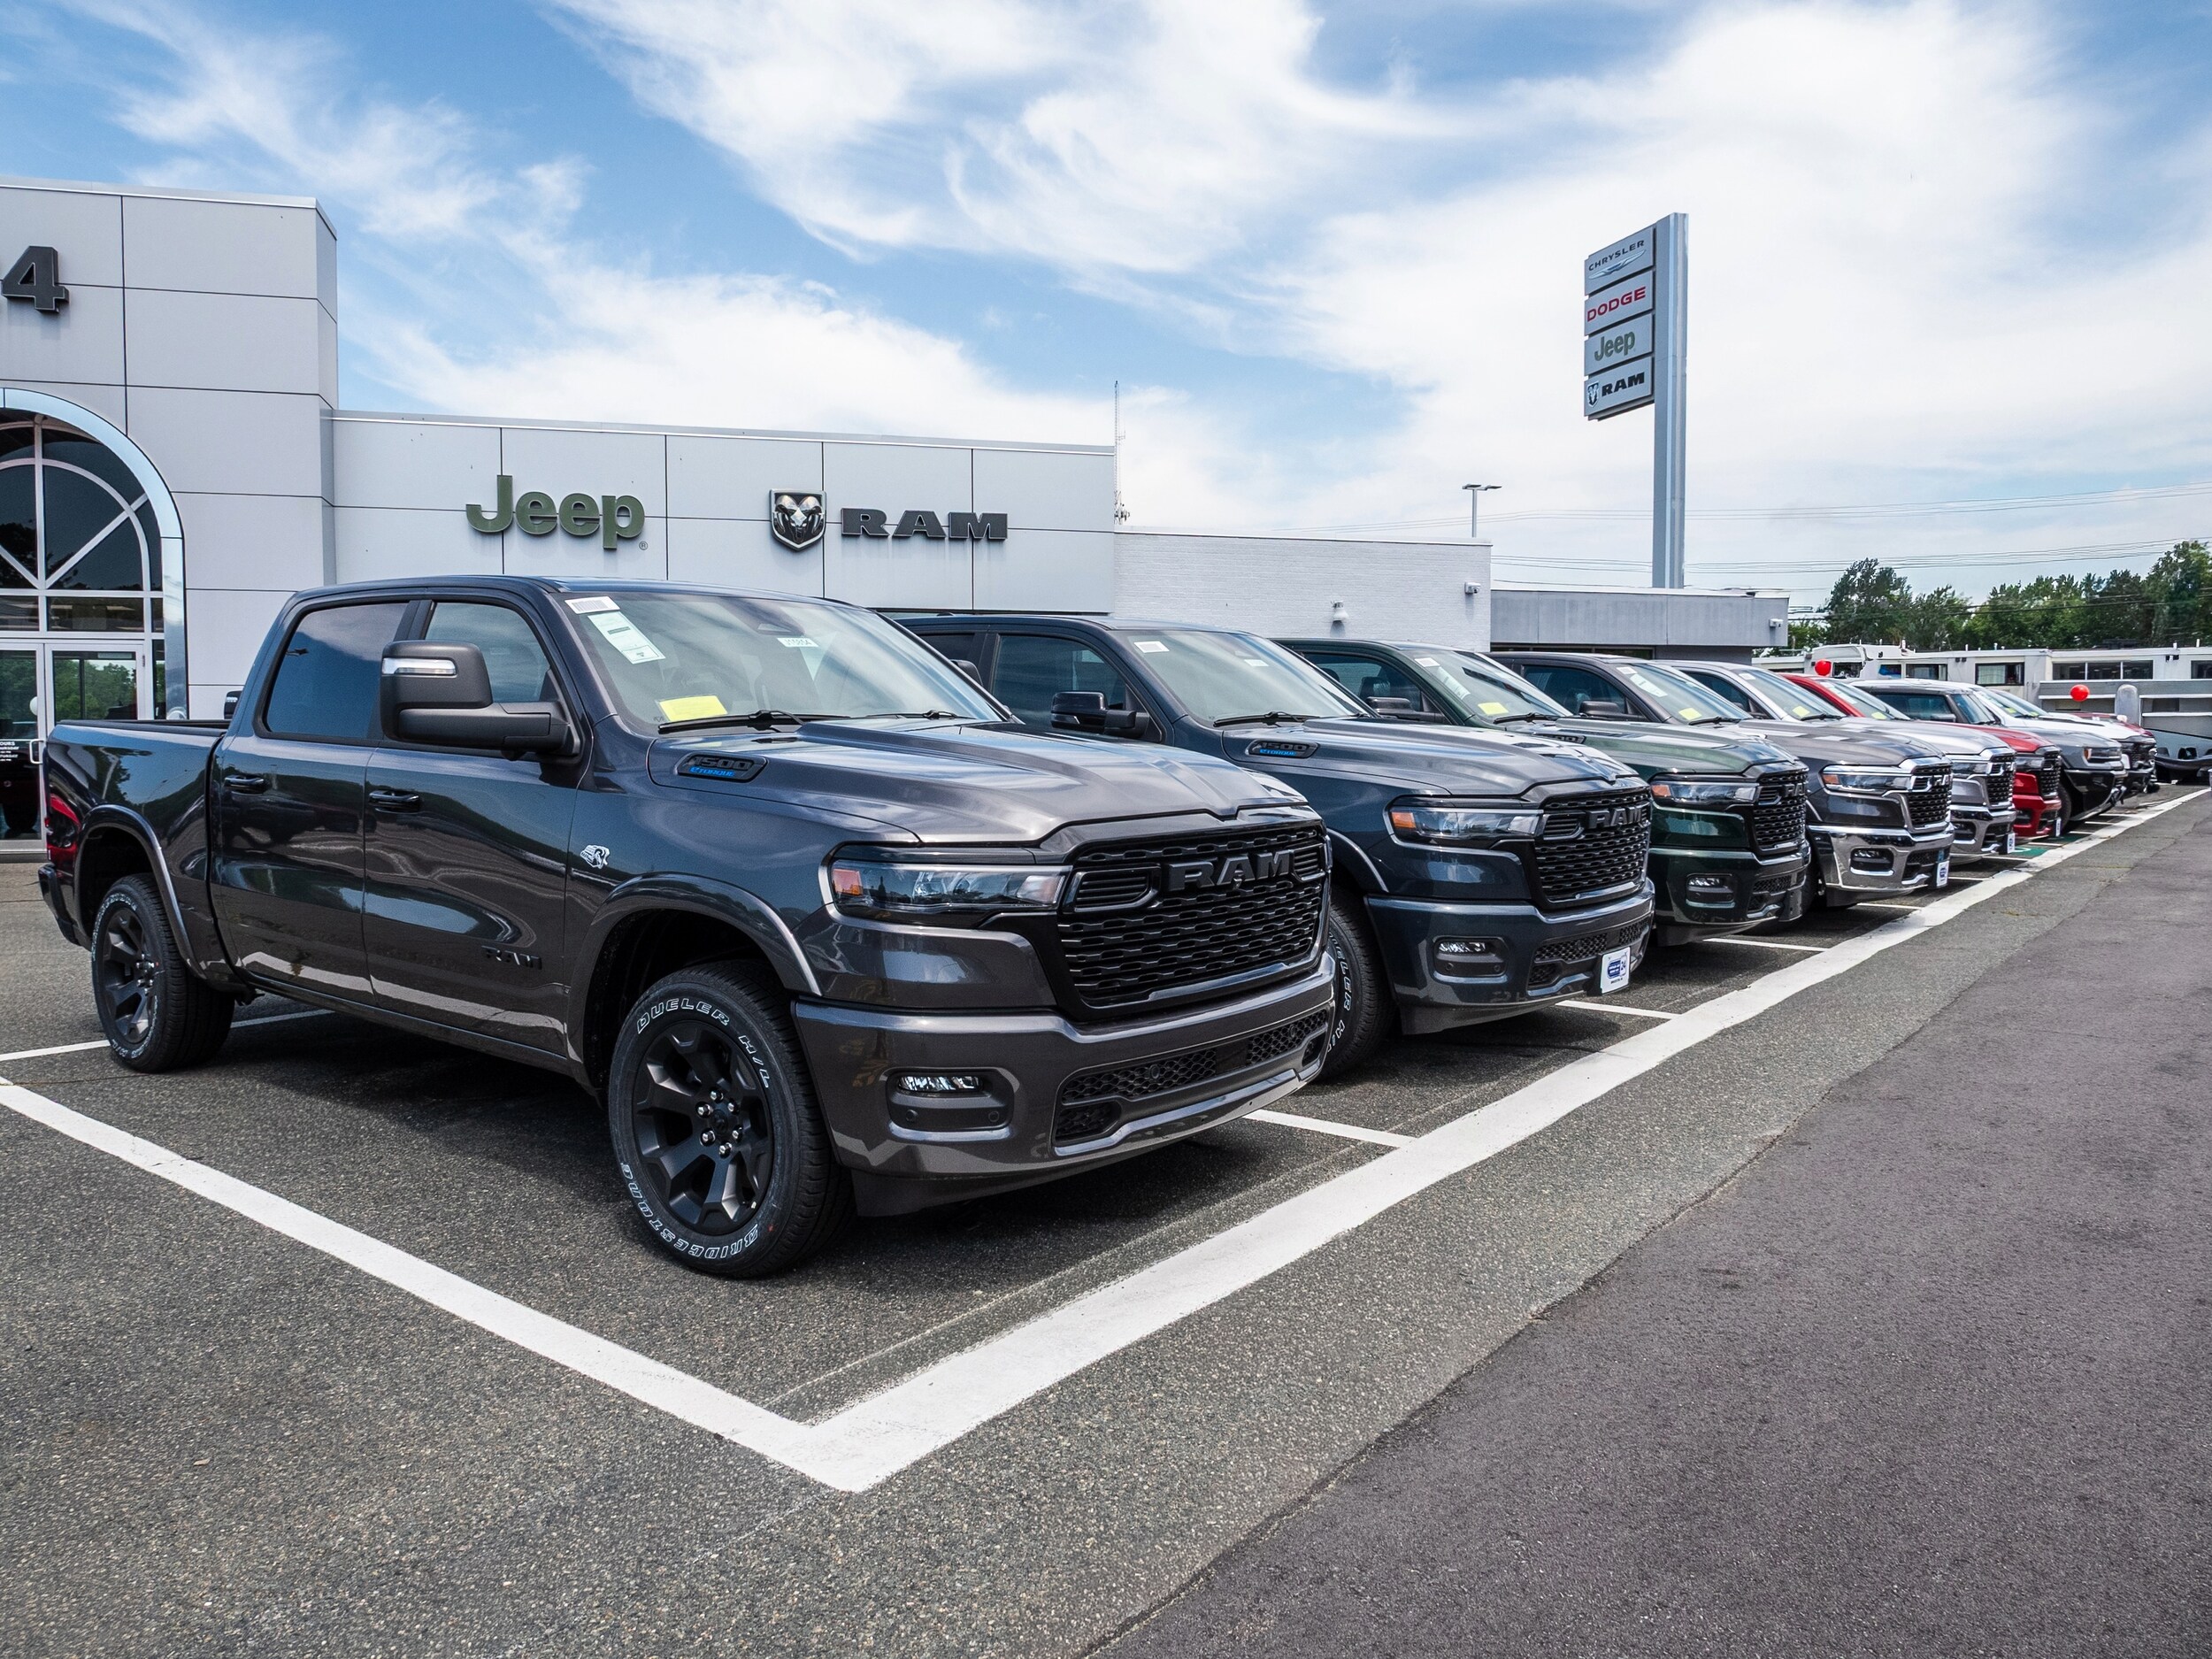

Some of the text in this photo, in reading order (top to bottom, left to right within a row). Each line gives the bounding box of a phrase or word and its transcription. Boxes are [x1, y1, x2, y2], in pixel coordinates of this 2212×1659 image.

[1588, 240, 1645, 271] CHRYSLER
[2, 245, 70, 312] 4
[1586, 286, 1647, 322] DODGE
[1594, 331, 1635, 361] Jeep
[1601, 372, 1646, 397] RAM
[465, 474, 645, 550] Jeep
[841, 507, 1009, 540] RAM
[691, 757, 749, 770] 1500
[1589, 805, 1643, 829] RAM
[1169, 850, 1291, 891] RAM
[635, 997, 730, 1034] DUELER
[619, 1162, 759, 1260] BRIDGESTONE
